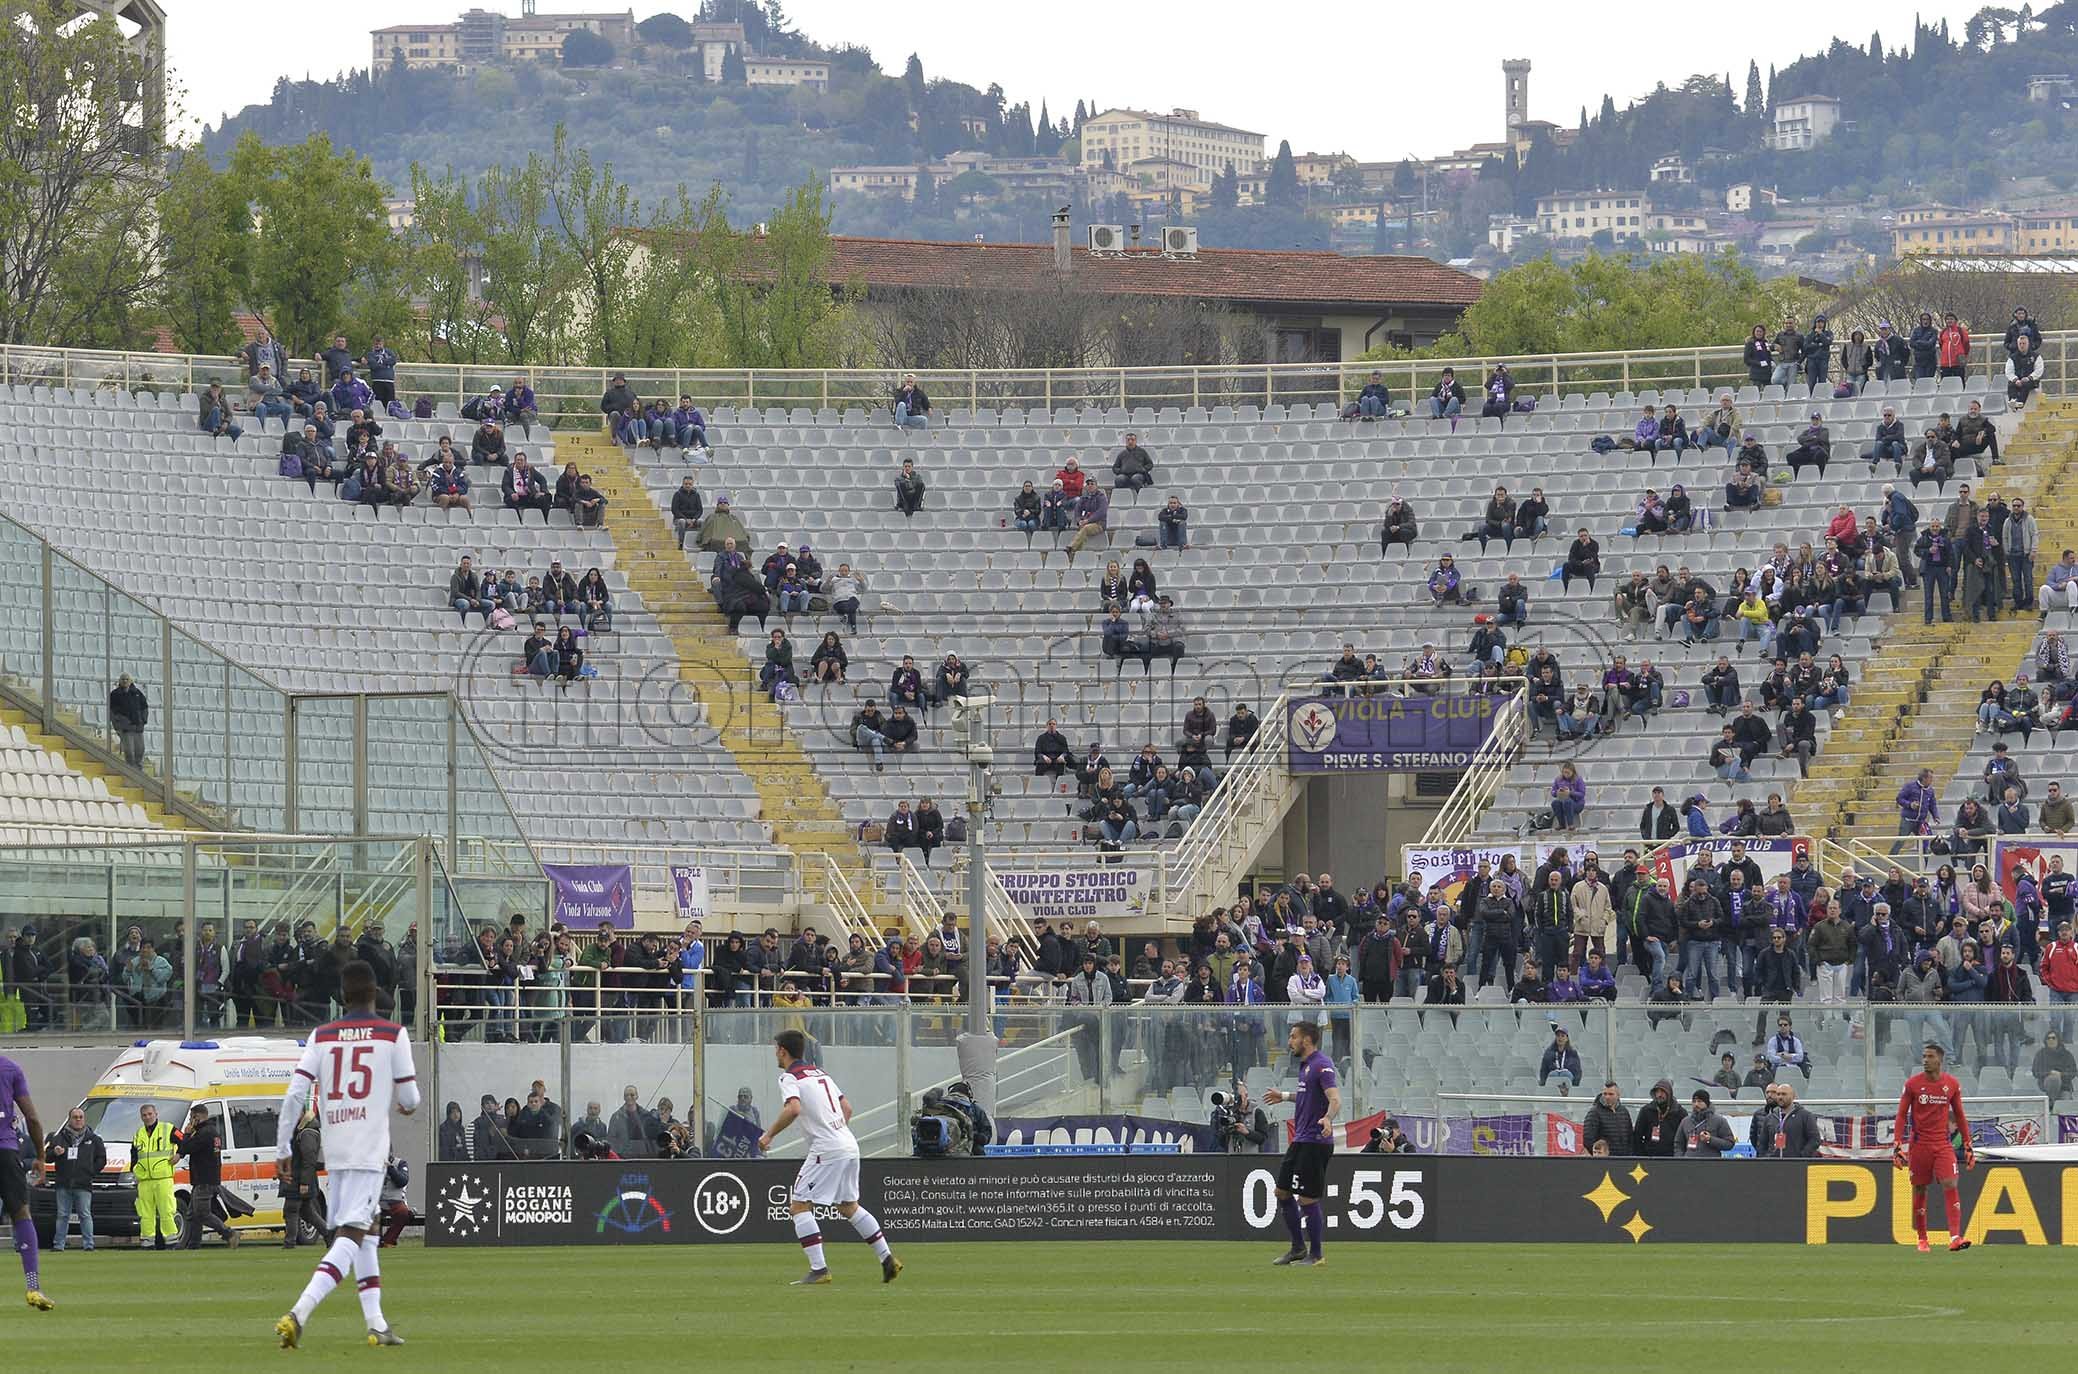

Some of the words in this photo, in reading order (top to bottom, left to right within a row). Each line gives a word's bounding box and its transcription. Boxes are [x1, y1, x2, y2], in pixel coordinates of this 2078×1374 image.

[1333, 701, 1406, 721] VIOLA
[1431, 699, 1492, 719] CLUB
[1323, 753, 1368, 769] PIEVE
[1372, 753, 1388, 768] S.
[1392, 752, 1468, 768] STEFANO
[1685, 840, 1732, 855] VIOLA
[1740, 839, 1772, 851] LUB
[1410, 849, 1501, 870] Sostenito
[1660, 861, 1668, 873] 2
[571, 880, 588, 893] Viola
[588, 880, 604, 893] Club
[994, 873, 1060, 889] GRUPPO
[1065, 871, 1137, 888] STORICO
[1005, 887, 1127, 905] MONTEFELTRO
[563, 902, 581, 917] Viola
[1033, 906, 1066, 916] VIOLA
[1068, 905, 1097, 915] CLUB
[338, 1027, 374, 1041] MBAYE
[327, 1046, 374, 1101] 15
[883, 1176, 921, 1186] Giocare
[931, 1175, 966, 1186] vietato
[978, 1175, 1010, 1185] minori
[1012, 1176, 1018, 1185] e
[1020, 1173, 1040, 1187] può
[1041, 1174, 1080, 1184] causare
[1082, 1172, 1120, 1183] disturbi
[1122, 1172, 1135, 1183] da
[1137, 1172, 1165, 1185] gioco
[1291, 1174, 1300, 1190] 5
[505, 1186, 572, 1199] AGENZIA
[920, 1189, 966, 1200] Consulta
[968, 1189, 978, 1200] le
[981, 1190, 1004, 1199] note
[1006, 1188, 1065, 1199] informative
[1066, 1187, 1092, 1198] sulle
[1153, 1186, 1162, 1197] di
[1165, 1186, 1200, 1197] vincita
[1202, 1188, 1214, 1197] su
[1242, 1168, 1425, 1230] 0:55
[505, 1199, 572, 1211] DOGANE
[702, 1191, 741, 1215] 18+
[1078, 1204, 1085, 1212] o
[1088, 1203, 1121, 1215] presso
[1129, 1202, 1157, 1214] punti
[1159, 1201, 1169, 1211] di
[1806, 1164, 2078, 1245] PLA
[505, 1211, 572, 1224] MONOPOLI
[883, 1219, 921, 1229] SKS365
[921, 1218, 948, 1229] Malta
[994, 1217, 1015, 1228] GAD
[1139, 1216, 1164, 1226] 4584
[1166, 1217, 1172, 1226] e
